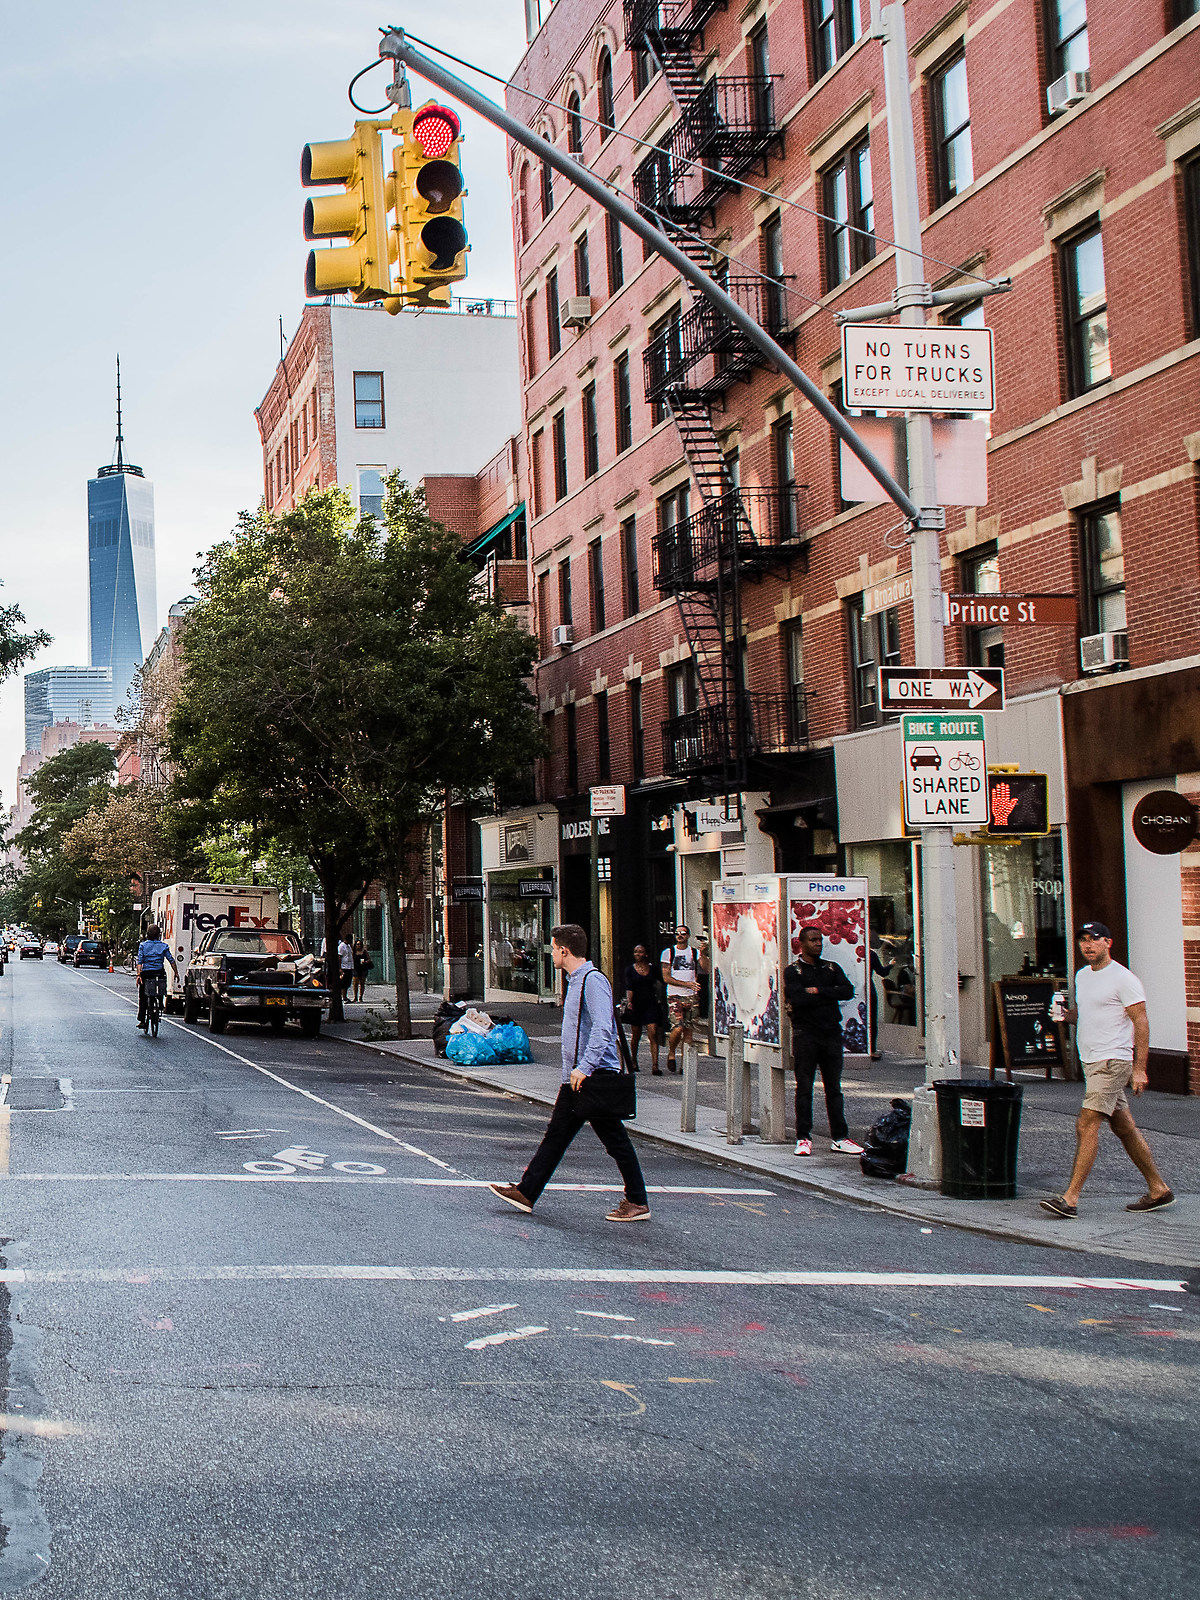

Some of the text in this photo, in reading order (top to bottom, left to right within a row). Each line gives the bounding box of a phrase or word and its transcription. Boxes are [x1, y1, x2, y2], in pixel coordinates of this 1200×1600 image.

[866, 342, 970, 359] NO TURNS
[855, 365, 983, 382] FOR TRUCKS
[853, 388, 985, 399] EXCEPT LOCAL DELIVERIES
[875, 579, 911, 608] Broadwa
[950, 600, 1036, 622] Prince St
[899, 681, 984, 697] ONE WAY
[908, 722, 979, 735] BIKE ROUTE
[913, 777, 980, 793] SHARED
[925, 799, 970, 814] LANE
[701, 812, 721, 826] Happy
[1141, 815, 1191, 825] CHOBANI
[521, 883, 552, 894] VILEBREQUIN
[809, 883, 847, 892] Phone
[182, 902, 272, 933] FedEx
[659, 921, 675, 935] SALE
